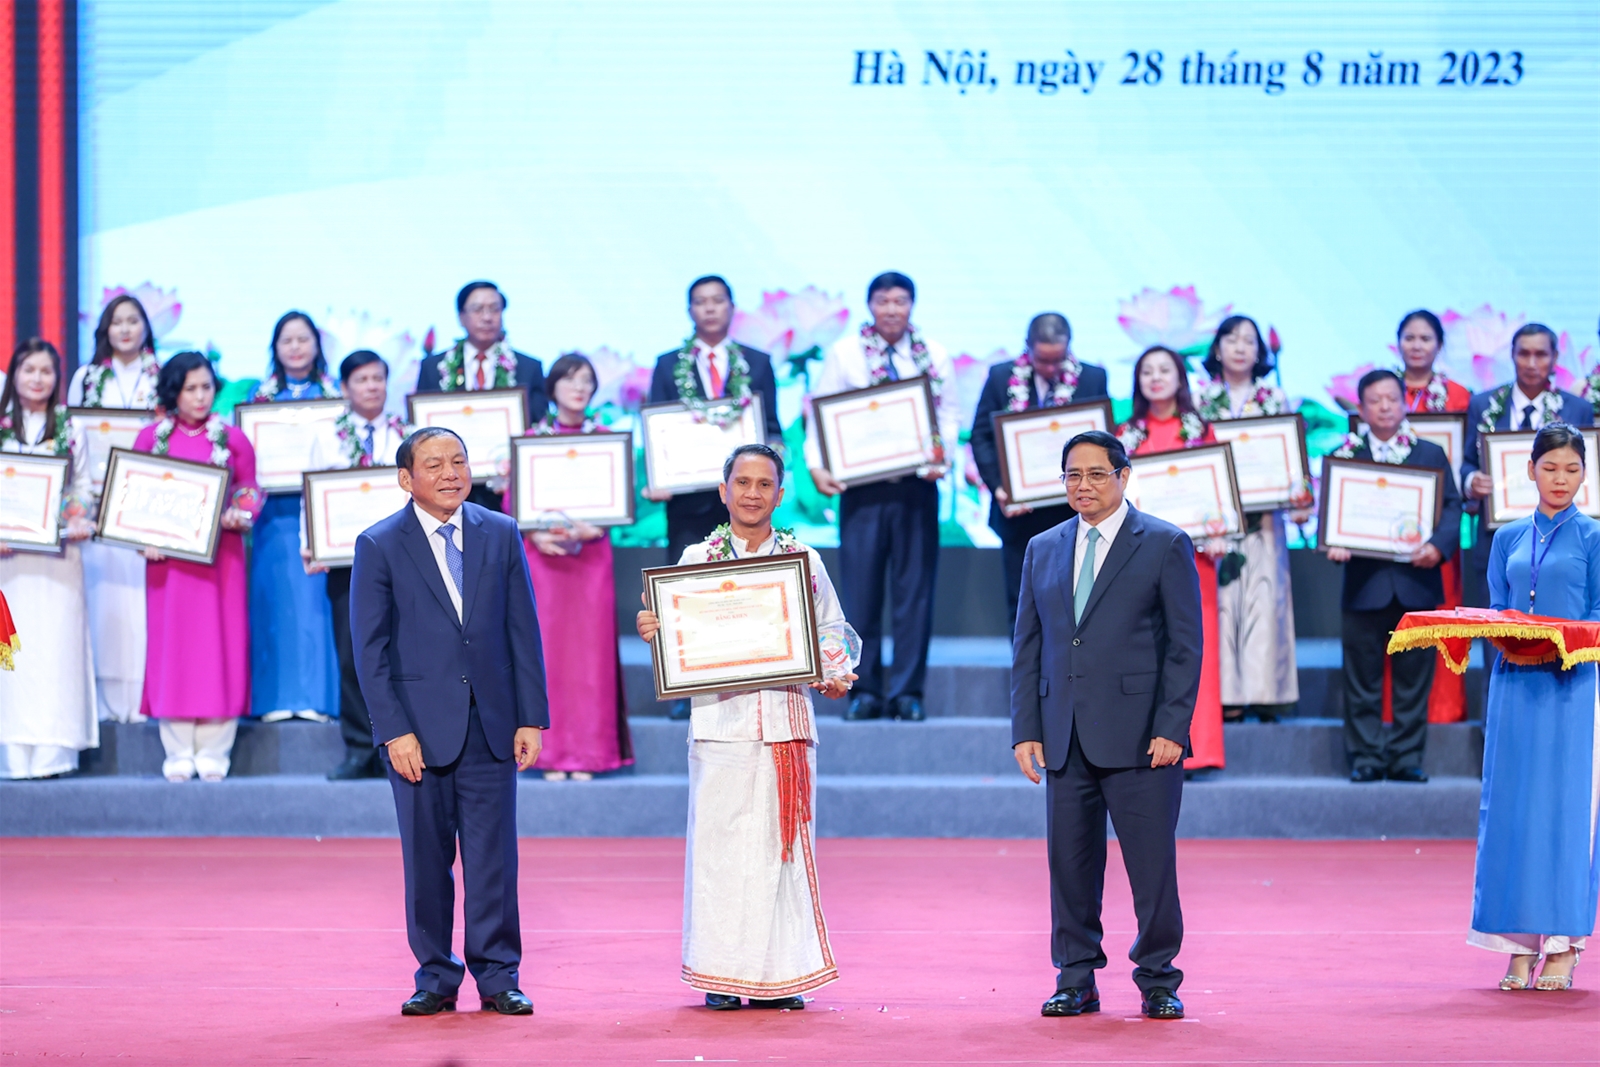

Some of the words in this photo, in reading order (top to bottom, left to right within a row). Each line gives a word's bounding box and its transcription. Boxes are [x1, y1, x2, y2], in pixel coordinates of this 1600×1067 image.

[852, 50, 905, 85] Hà
[922, 50, 998, 95] Nội,
[1015, 50, 1103, 95] ngày
[1120, 51, 1164, 85] 28
[1180, 50, 1286, 95] tháng
[1301, 51, 1324, 86] 8
[1339, 50, 1421, 86] năm
[1436, 50, 1526, 87] 2023
